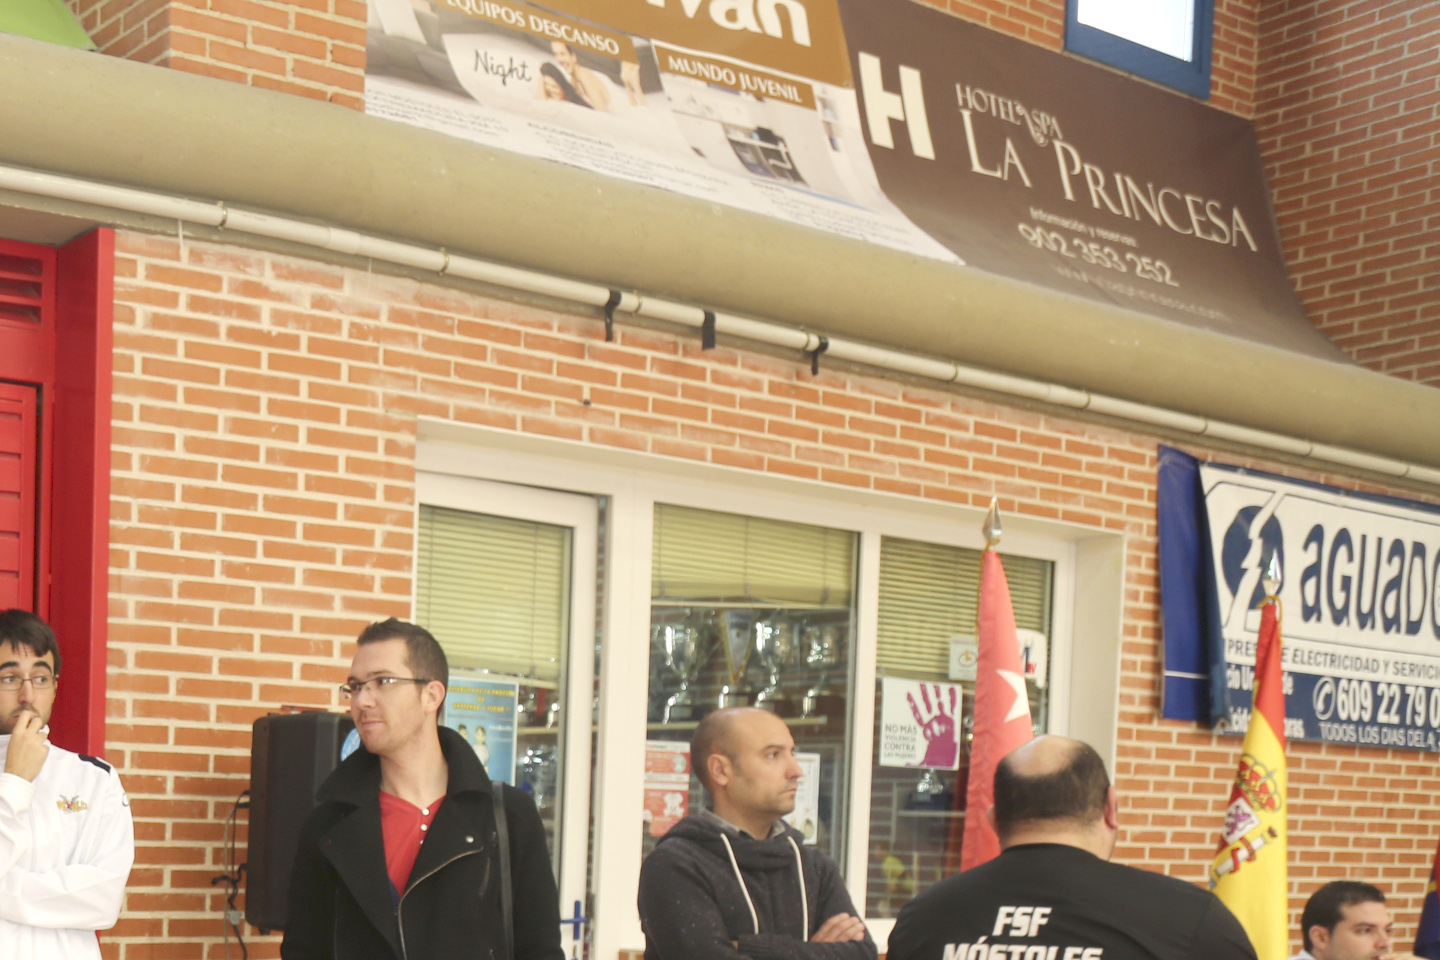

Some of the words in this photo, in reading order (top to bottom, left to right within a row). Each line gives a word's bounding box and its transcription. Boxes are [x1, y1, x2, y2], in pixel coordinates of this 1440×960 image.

[529, 14, 619, 55] DESCANSO
[474, 50, 532, 87] Night
[668, 55, 736, 86] MUNDO
[739, 72, 803, 103] JUVENIL
[859, 51, 935, 160] H
[955, 83, 1021, 125] HOTEL
[1031, 108, 1063, 140] SPA
[959, 108, 1032, 188] LA
[1052, 138, 1258, 252] PRINCESA
[1072, 238, 1127, 272] 353
[1125, 252, 1180, 288] 252
[1293, 648, 1379, 673] ELECTRICIDAD
[1383, 660, 1391, 675] Y
[1337, 678, 1373, 722] 609
[1377, 682, 1401, 725] 22
[1405, 685, 1427, 727] 79
[1319, 722, 1357, 742] TODOS
[1358, 725, 1380, 744] LOS
[992, 906, 1053, 937] FSF
